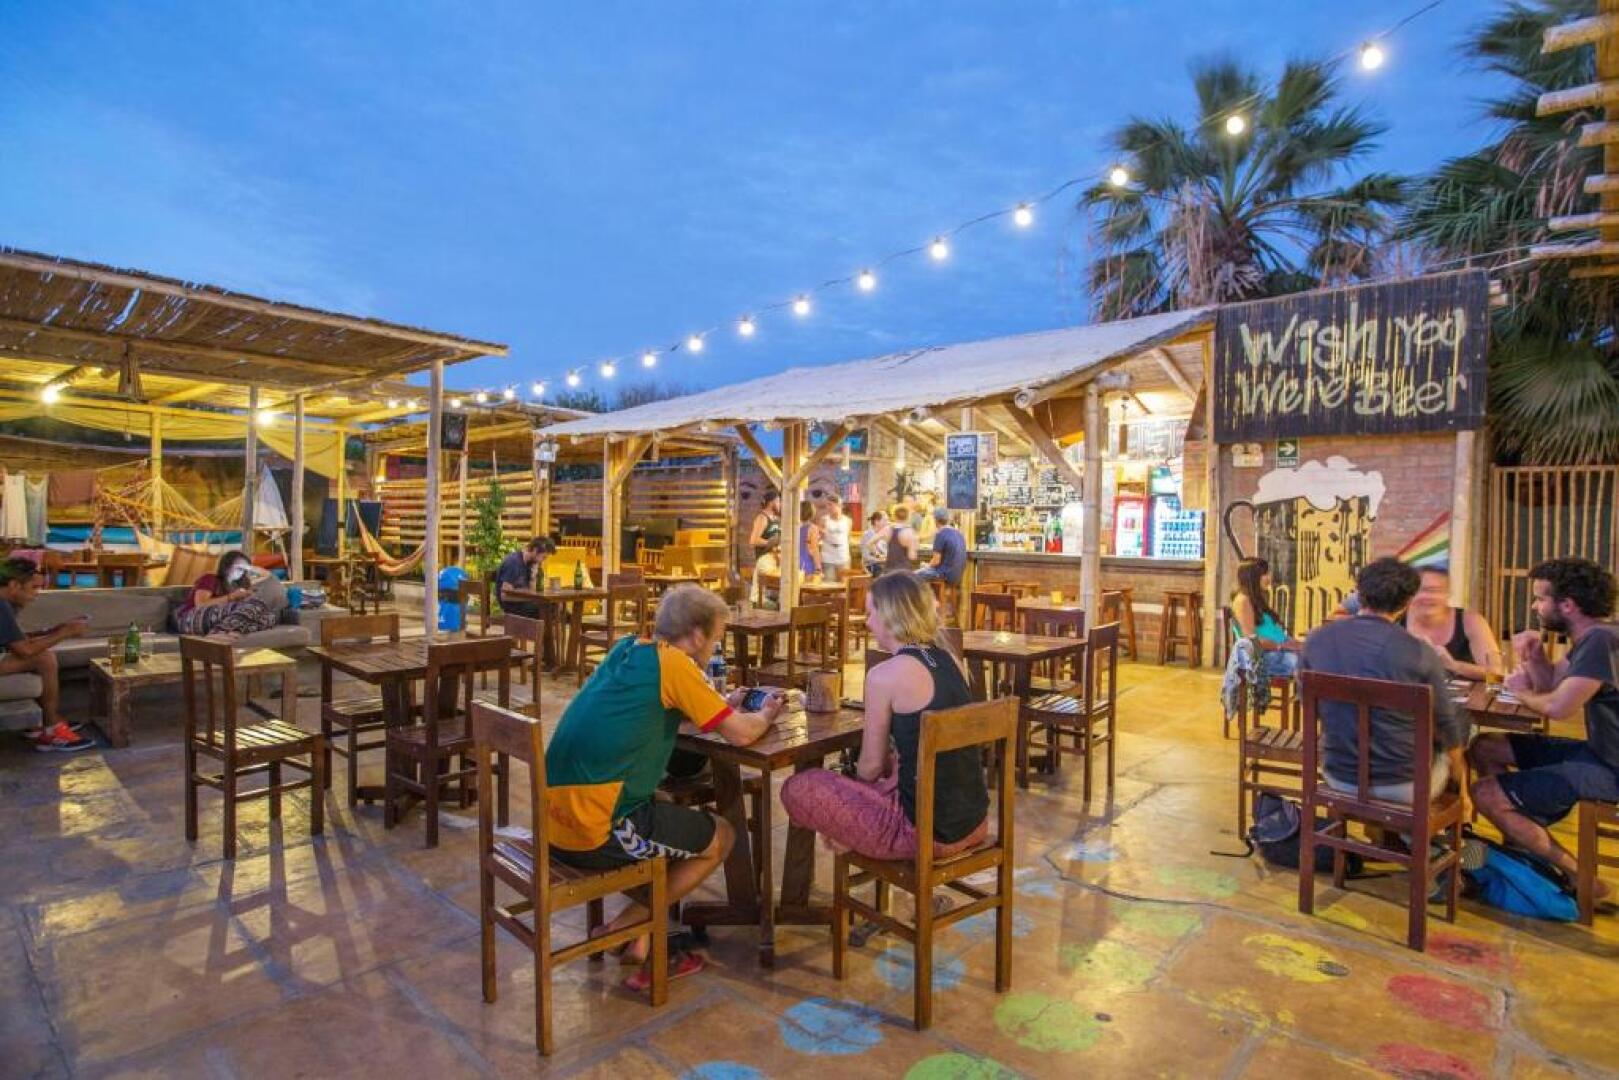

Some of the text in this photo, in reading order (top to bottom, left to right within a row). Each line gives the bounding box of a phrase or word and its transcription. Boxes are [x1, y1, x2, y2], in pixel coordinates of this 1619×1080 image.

[1239, 300, 1466, 369] Wish You
[1235, 369, 1467, 417] Were Beer
